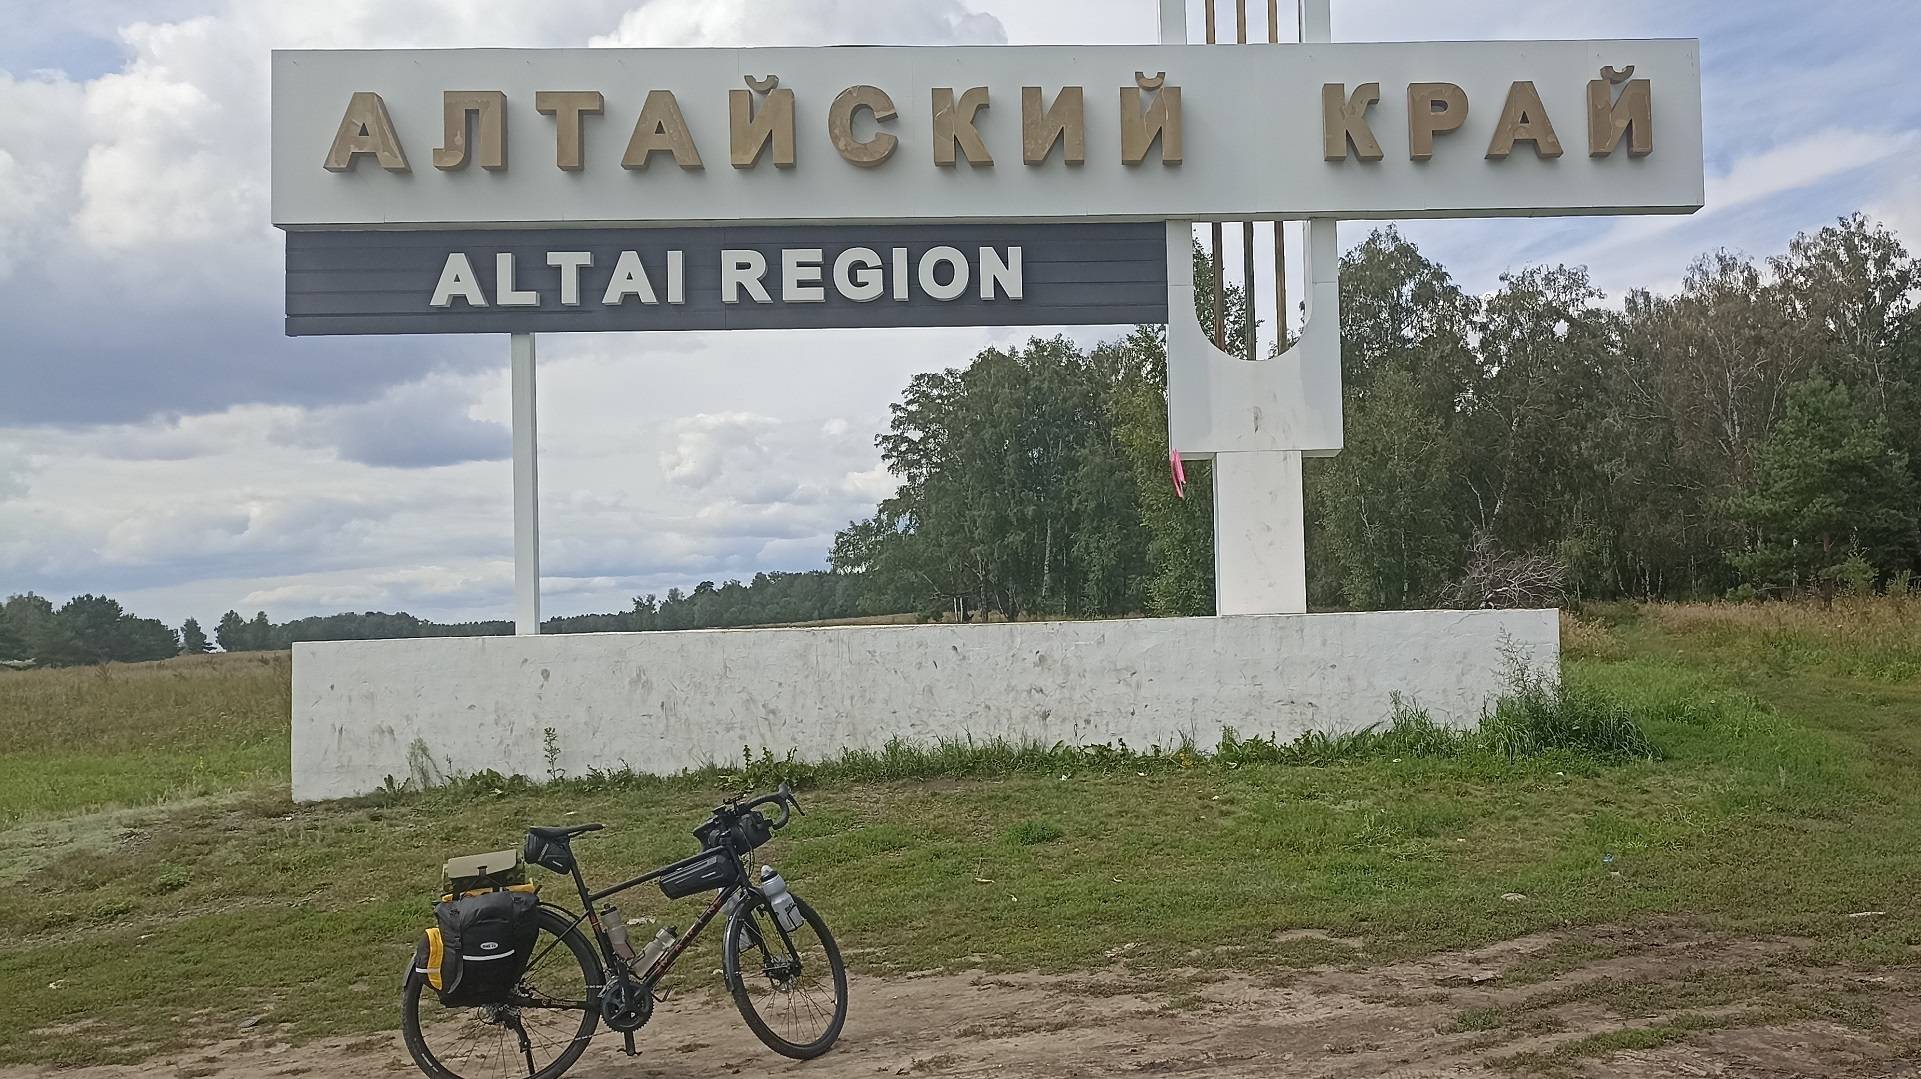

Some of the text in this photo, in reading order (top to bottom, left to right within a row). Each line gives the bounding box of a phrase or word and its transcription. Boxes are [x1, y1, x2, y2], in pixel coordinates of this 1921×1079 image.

[323, 65, 1653, 172] АЛТАЙСКИЙ КРАЙ
[429, 245, 1024, 307] ALTAI REGION
